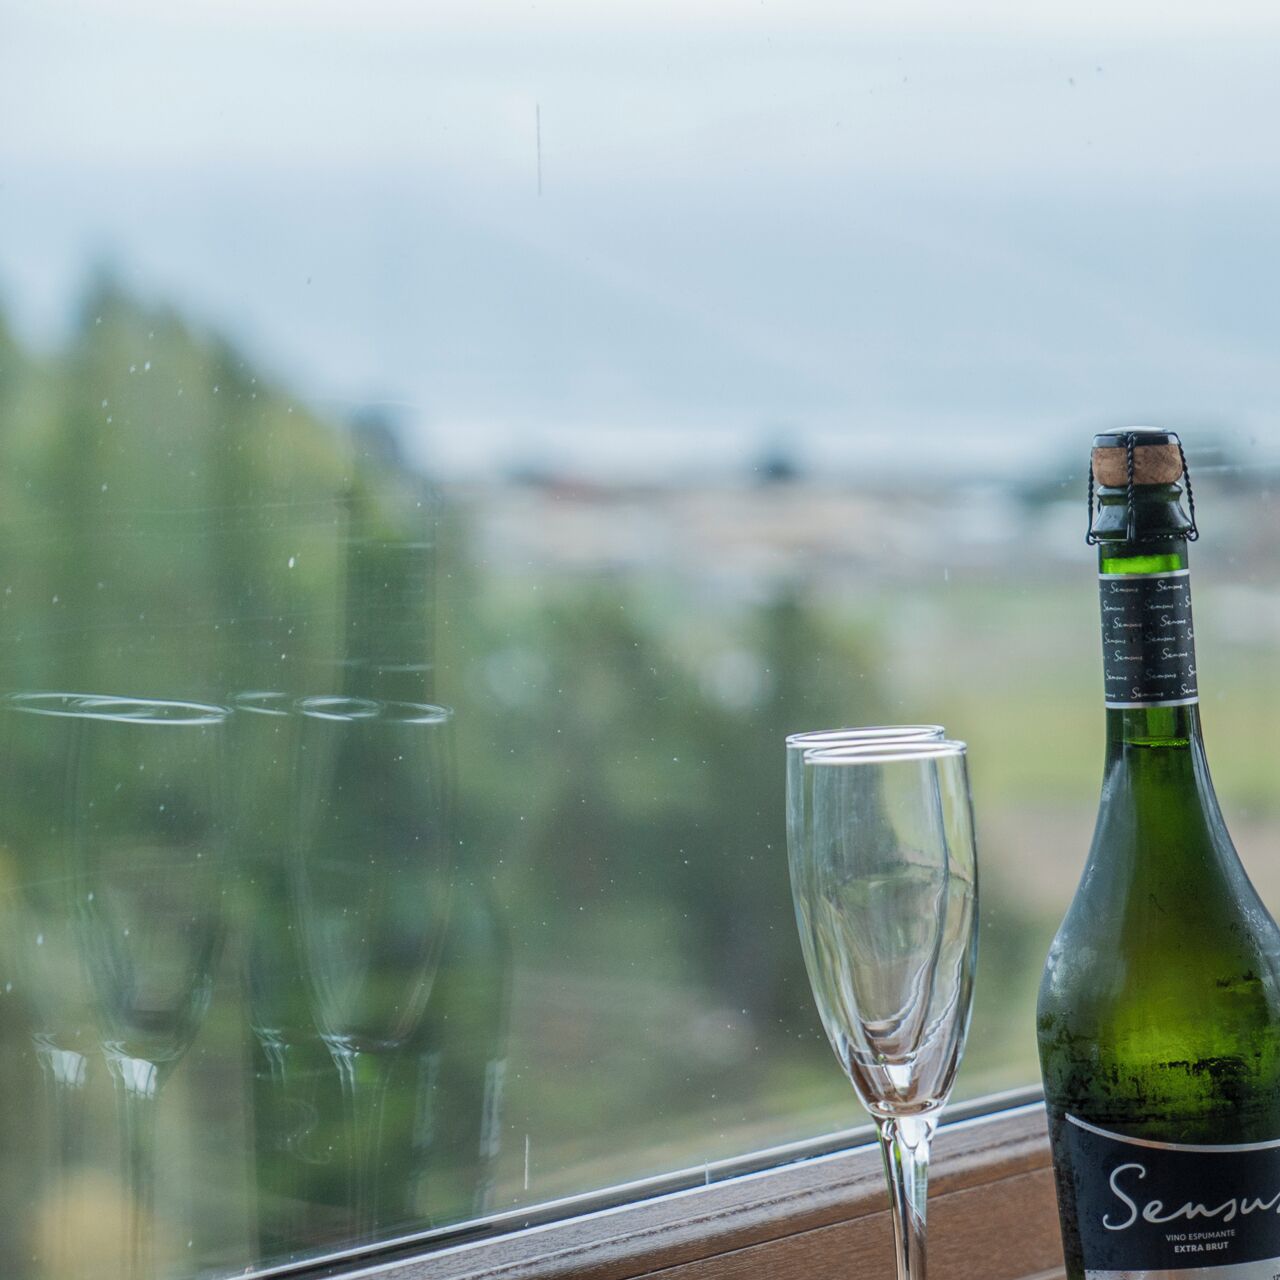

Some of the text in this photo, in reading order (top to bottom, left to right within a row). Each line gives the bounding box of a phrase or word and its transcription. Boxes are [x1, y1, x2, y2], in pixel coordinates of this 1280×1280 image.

[1165, 1229, 1236, 1242] VINO ESPUMANTE
[1174, 1241, 1229, 1253] EXTRA BRUT
